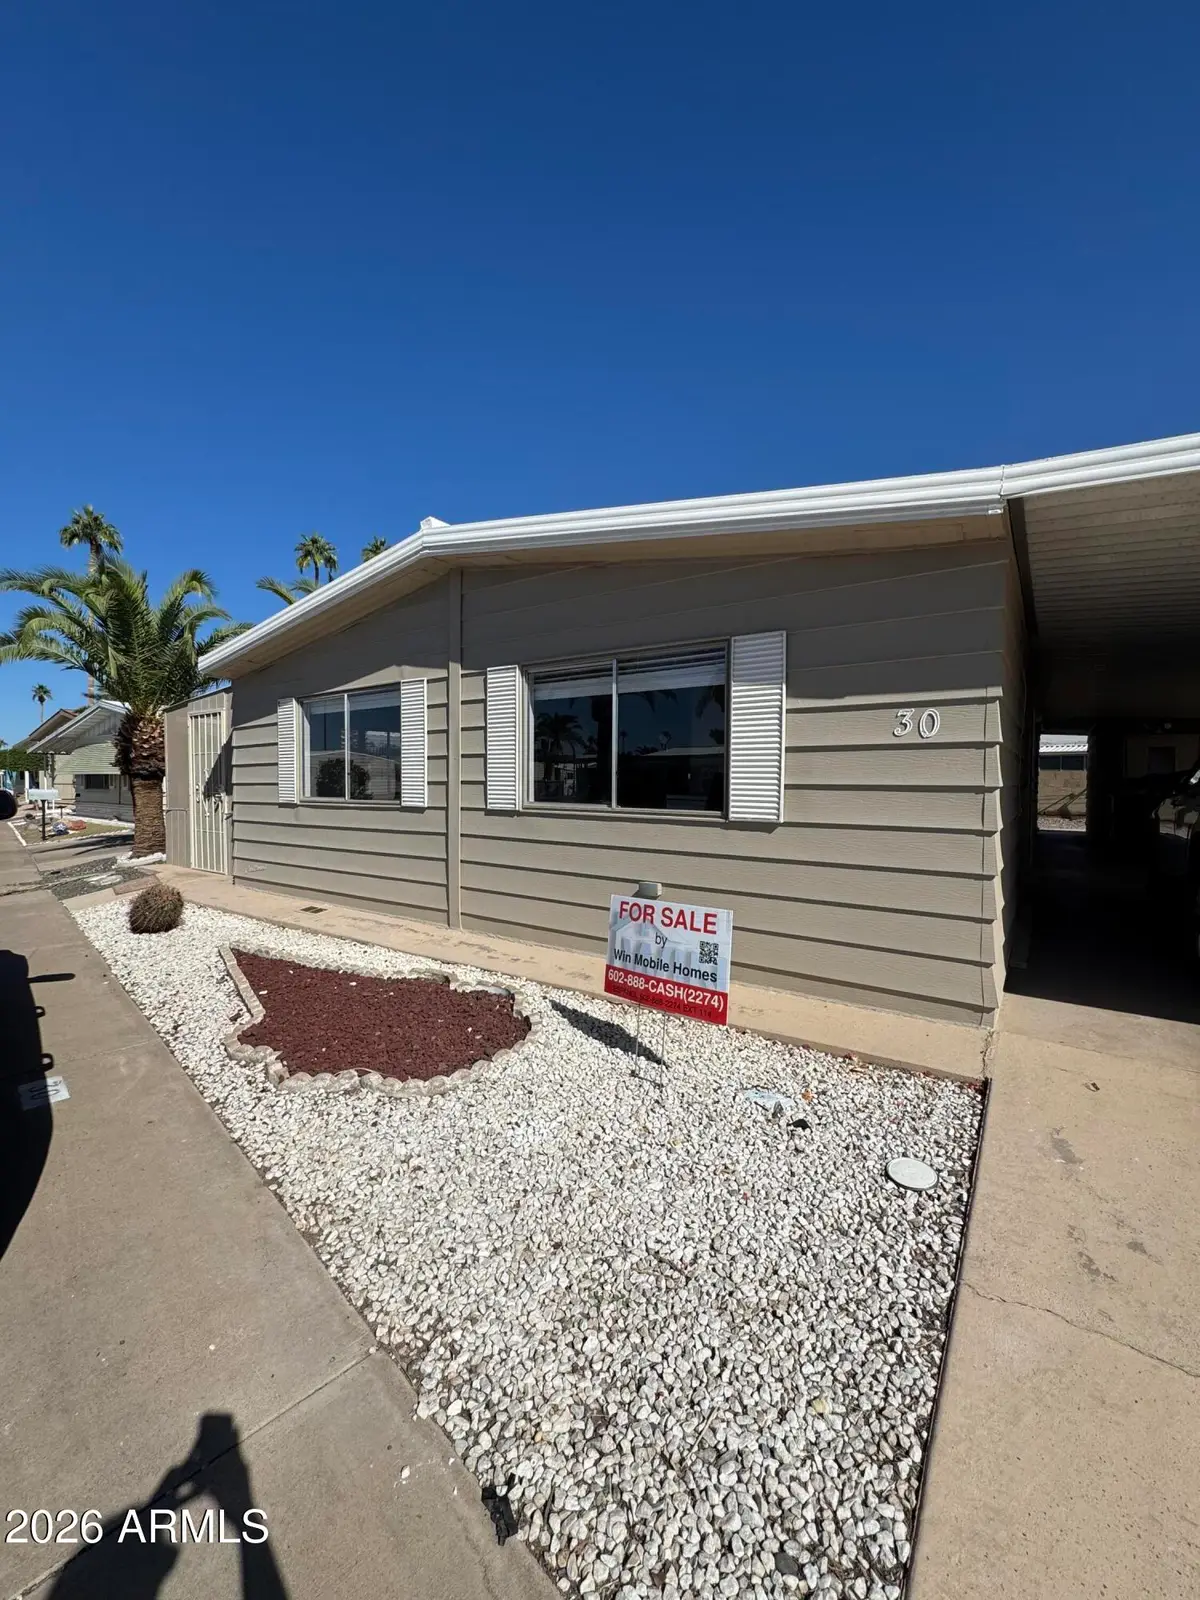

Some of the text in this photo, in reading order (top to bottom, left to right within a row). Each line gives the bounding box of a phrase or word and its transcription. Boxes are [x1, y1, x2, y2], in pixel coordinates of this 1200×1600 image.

[893, 708, 941, 738] 30
[619, 901, 717, 935] FOR SALE
[654, 932, 668, 948] by
[613, 948, 718, 983] Win Mobile Homes
[608, 969, 724, 1011] 602-888-CASH(2274)
